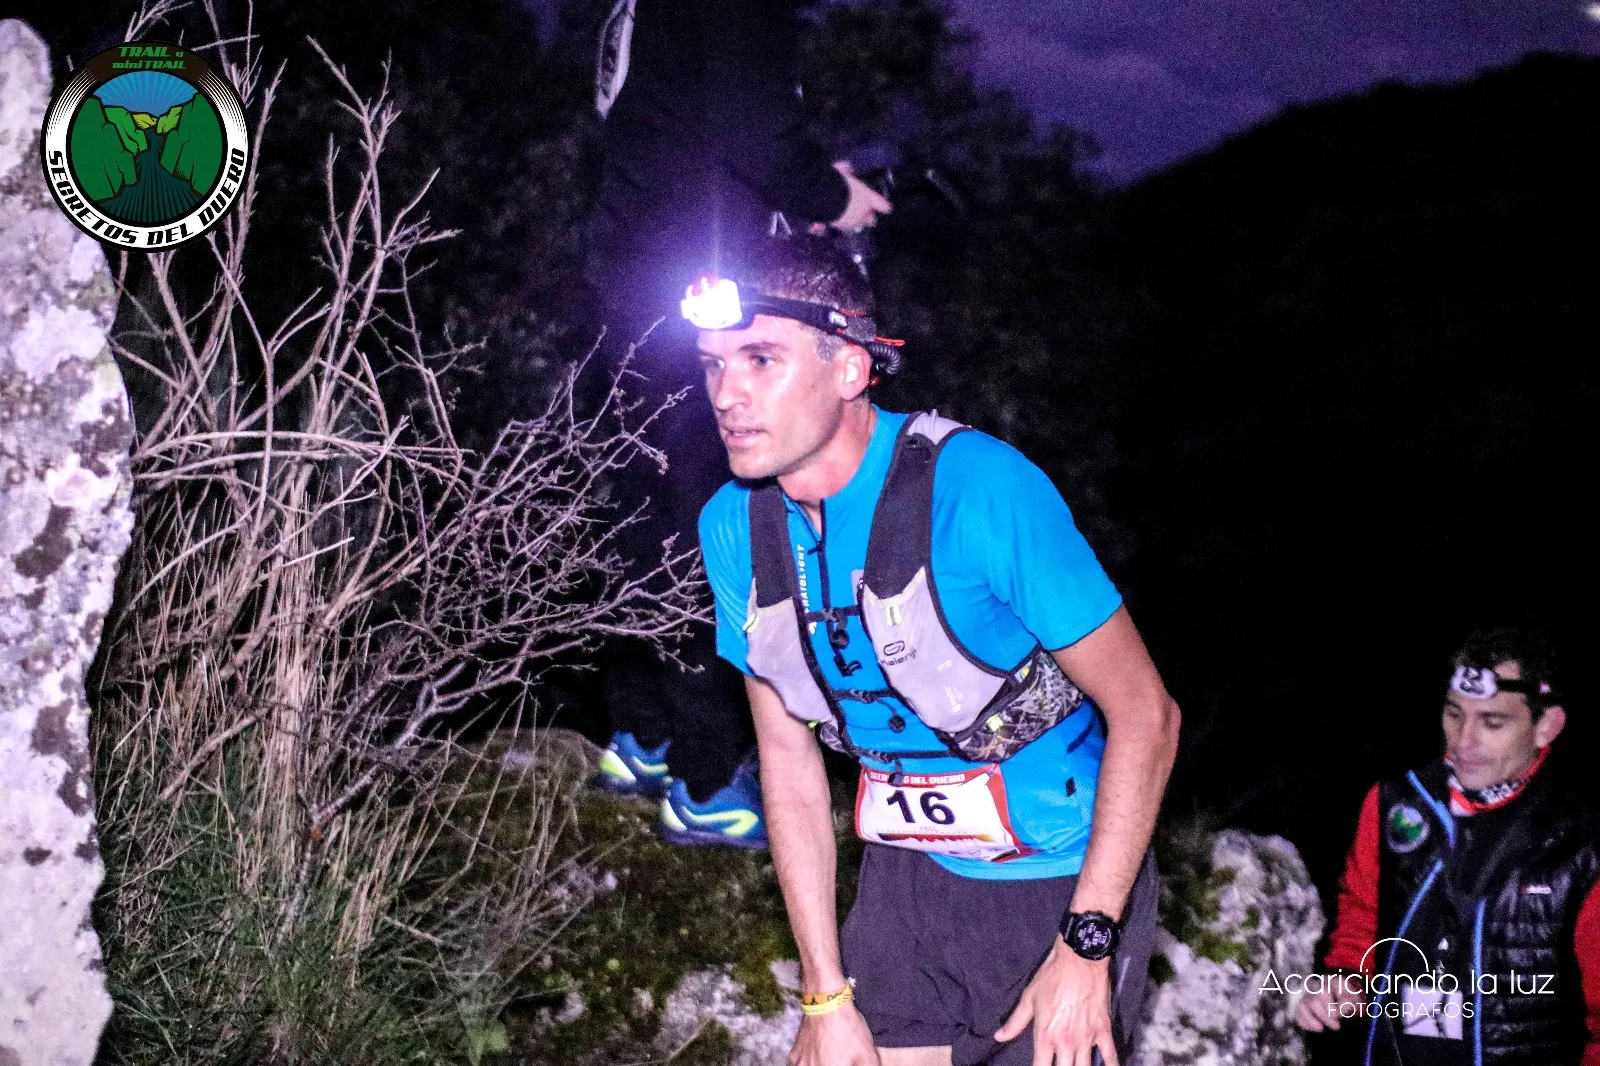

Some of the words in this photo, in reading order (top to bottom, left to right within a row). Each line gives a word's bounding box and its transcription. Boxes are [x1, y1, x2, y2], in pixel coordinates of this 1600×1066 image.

[870, 771, 909, 783] SECRS
[910, 776, 928, 784] DEL
[929, 774, 965, 784] DUERO
[886, 789, 956, 826] 16
